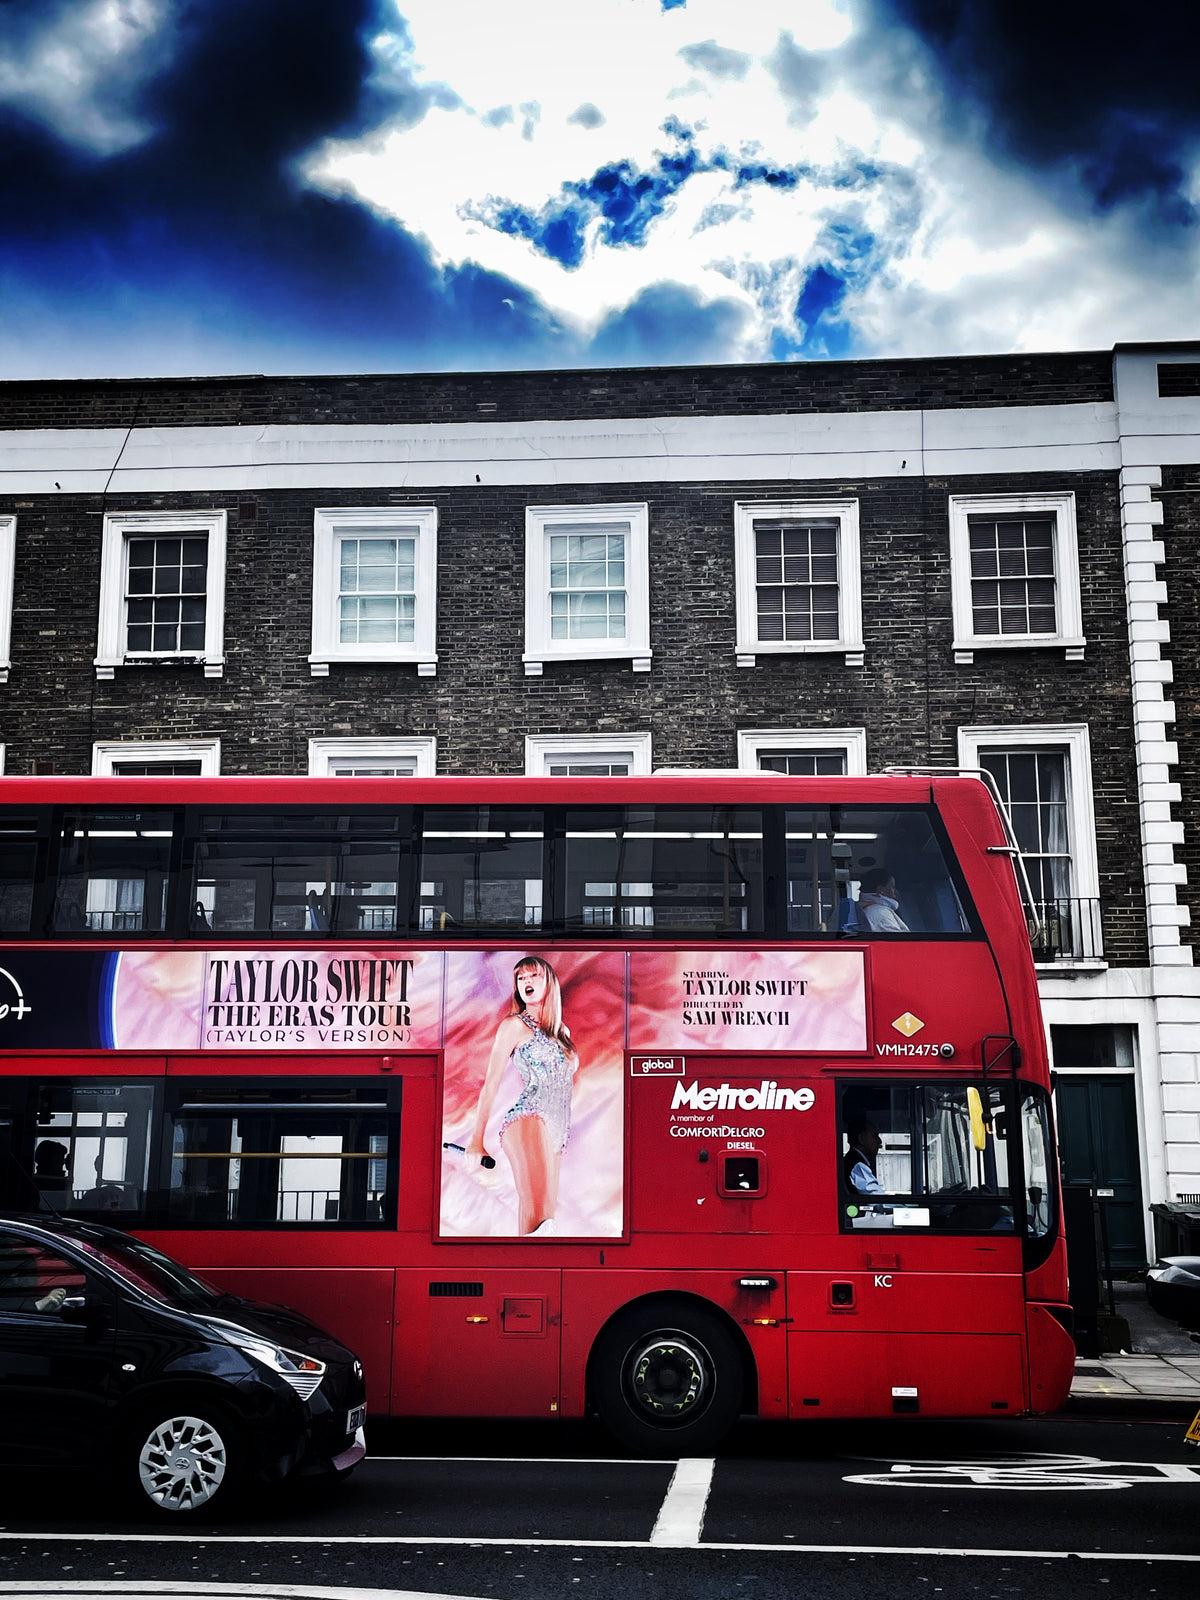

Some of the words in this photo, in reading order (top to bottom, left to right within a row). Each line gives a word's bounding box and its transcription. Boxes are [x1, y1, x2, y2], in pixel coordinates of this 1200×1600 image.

[210, 959, 319, 1003] TAYLOR
[326, 959, 414, 1003] SWIFT
[682, 980, 751, 996] TAYLOR
[755, 980, 808, 996] SWIFT
[208, 1005, 260, 1026] THE
[268, 1005, 335, 1026] ERAS
[342, 1005, 411, 1026] TOUR
[682, 1011, 717, 1025] SAM
[721, 1011, 790, 1025] WRENCH
[206, 1029, 305, 1042] (TAYLOR'S
[318, 1029, 411, 1042] VERSION)
[876, 1044, 939, 1056] VMH2475
[641, 1059, 674, 1073] global
[670, 1079, 816, 1111] Metroline
[677, 1114, 705, 1122] member
[706, 1114, 714, 1122] of
[727, 1141, 755, 1150] DIESEL
[874, 1275, 892, 1287] KC
